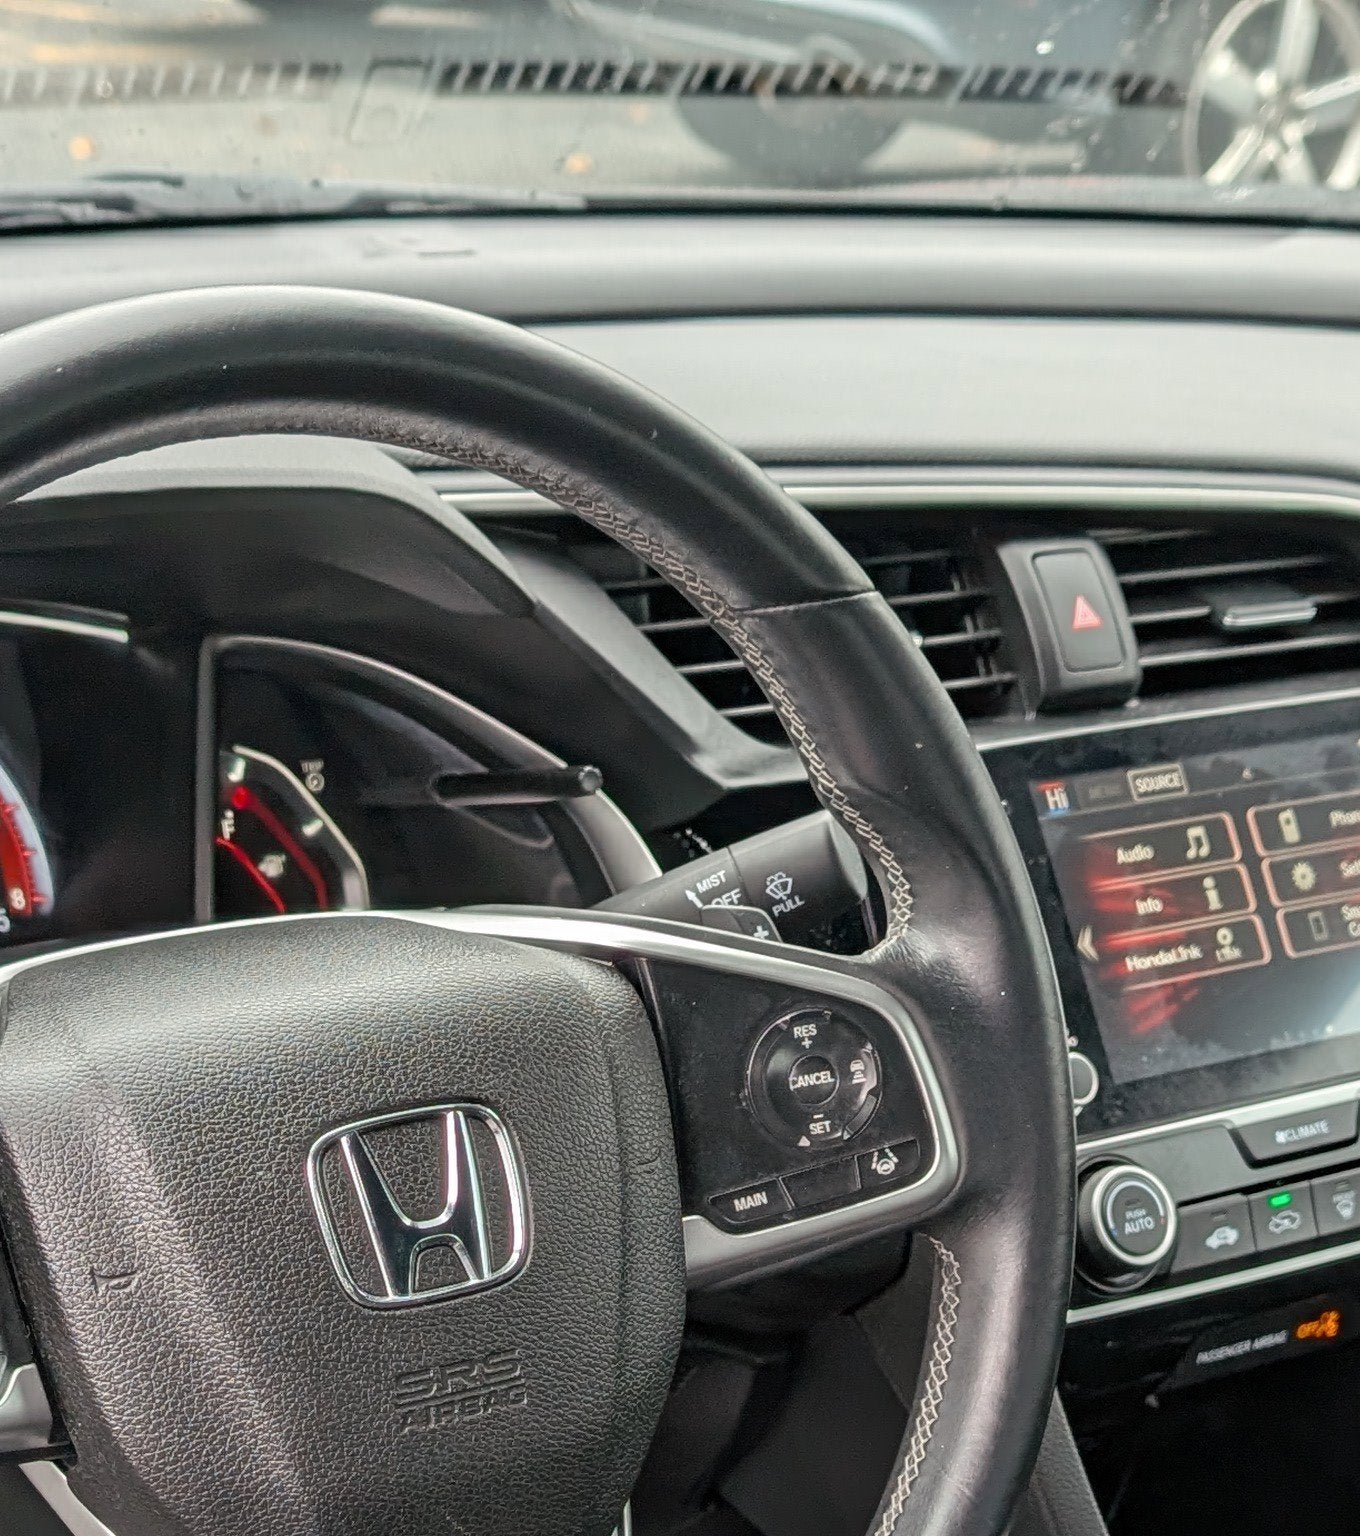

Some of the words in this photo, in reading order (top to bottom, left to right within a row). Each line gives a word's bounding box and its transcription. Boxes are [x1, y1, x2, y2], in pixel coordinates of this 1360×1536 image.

[1116, 843, 1155, 865] Audio
[695, 870, 727, 894] MIST
[8, 887, 26, 911] 8
[771, 895, 806, 918] PULL
[1135, 896, 1164, 916] Info
[793, 1023, 818, 1039] RES
[789, 1070, 835, 1089] CANCEL
[808, 1119, 832, 1135] SET
[1286, 1119, 1330, 1143] CLIMATE
[733, 1191, 768, 1212] MAIN
[1123, 1216, 1156, 1235] AUTO
[392, 1350, 522, 1408] SRS
